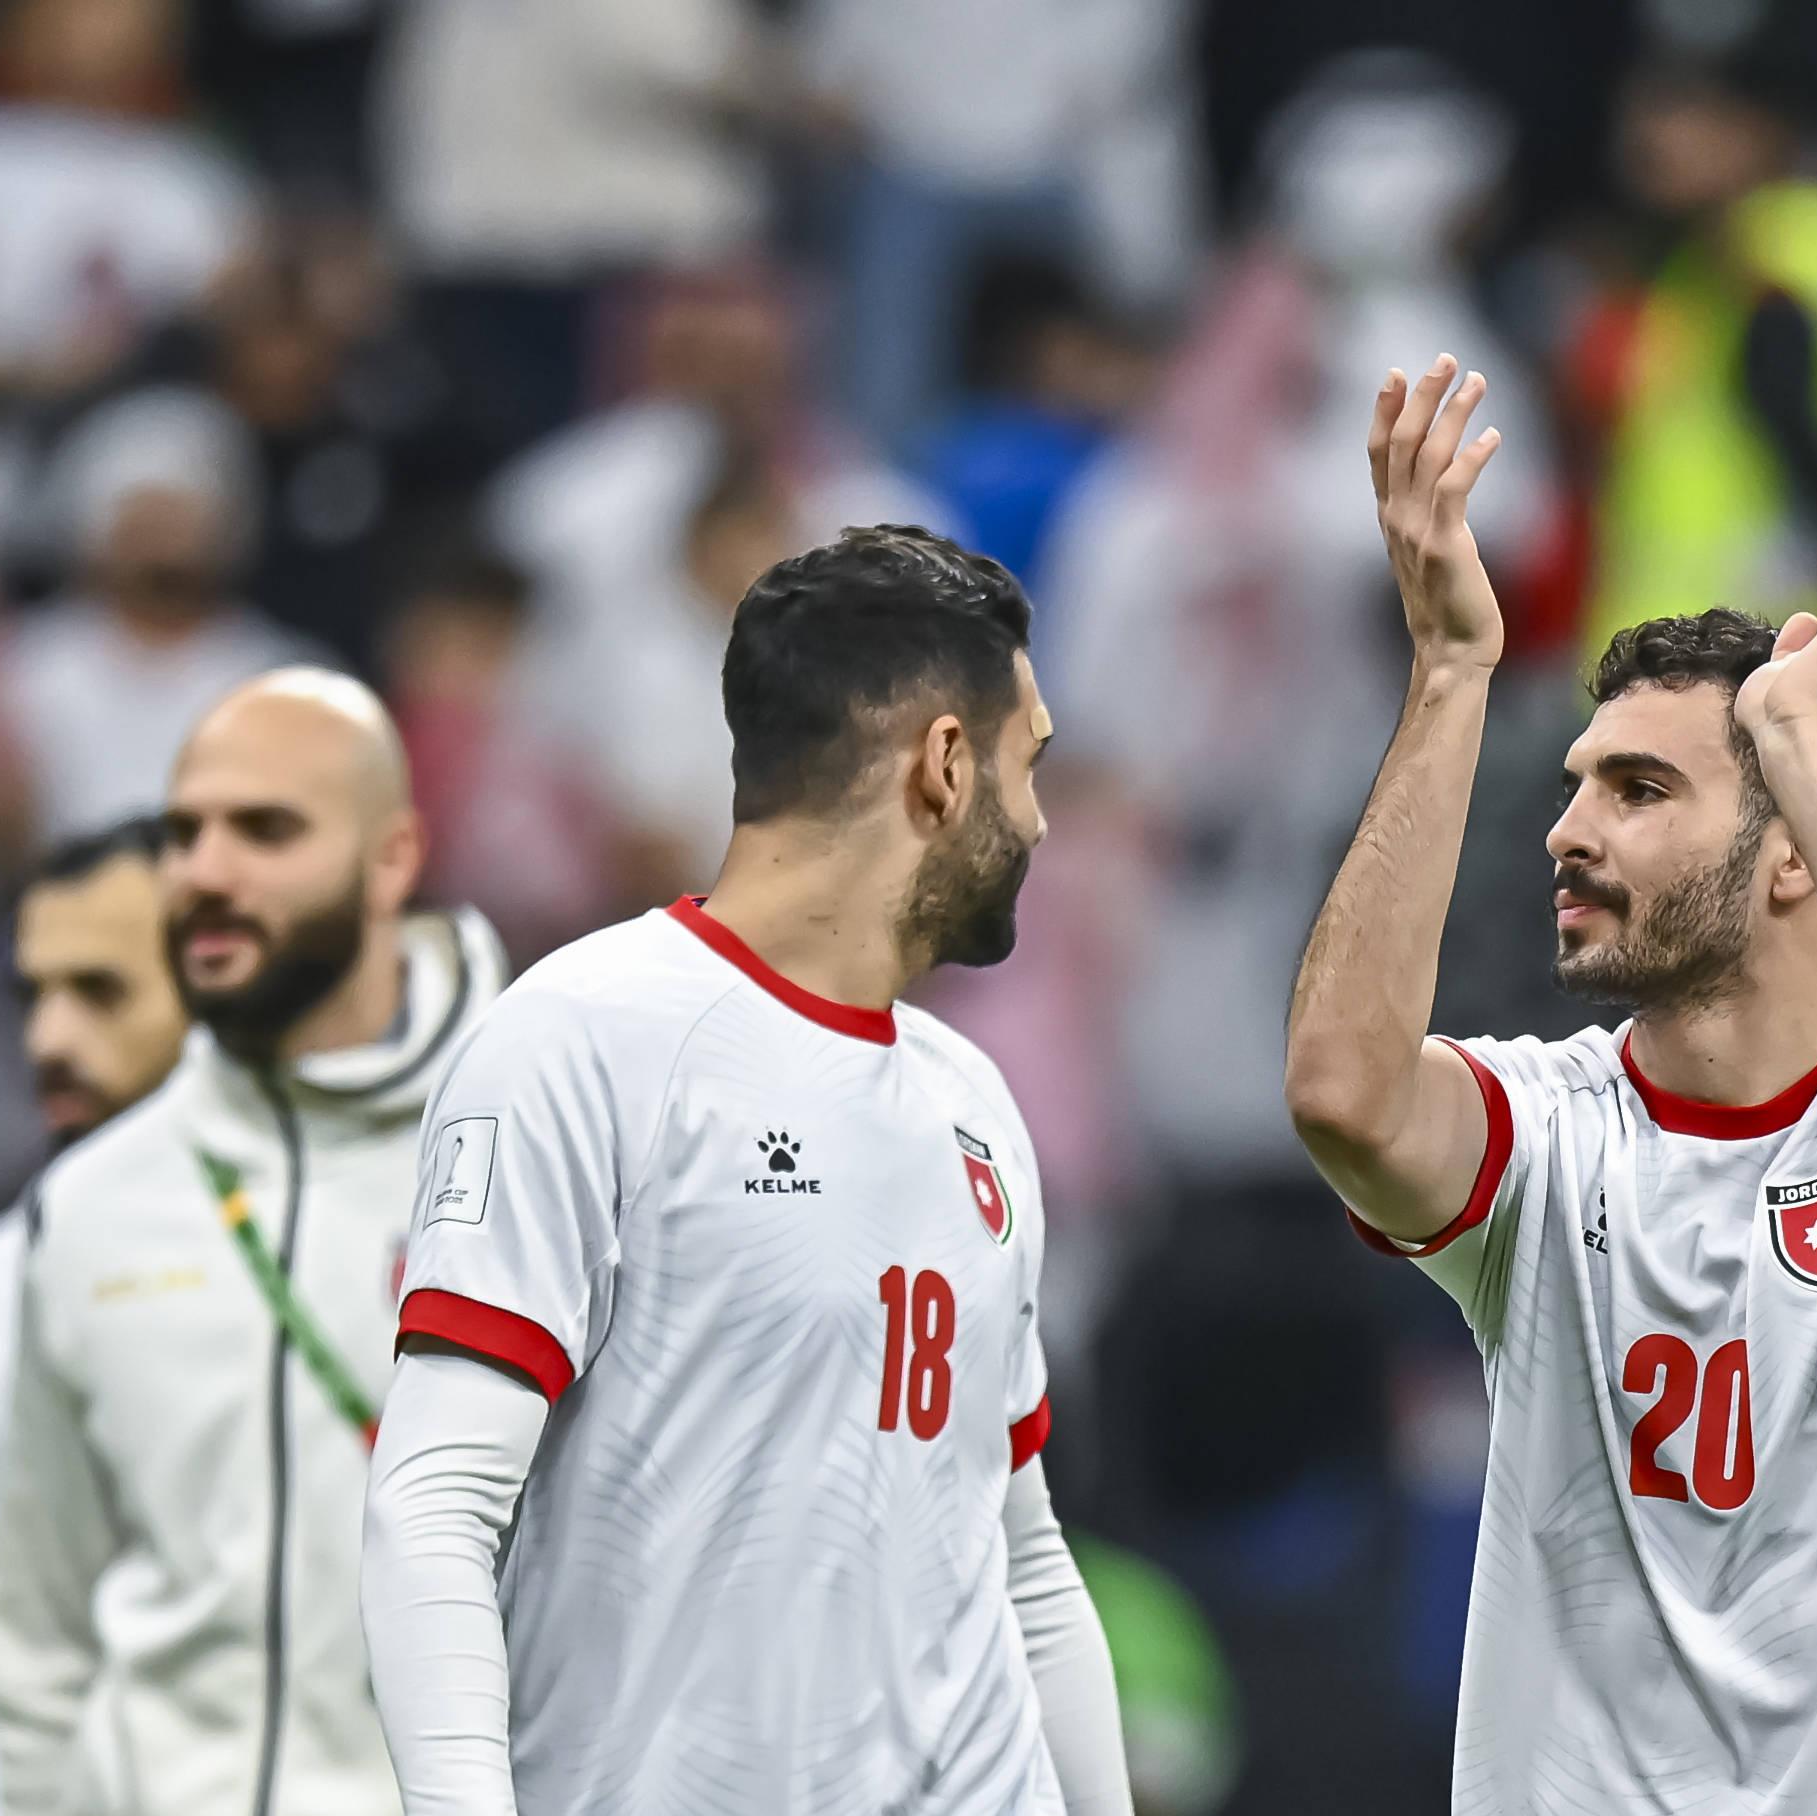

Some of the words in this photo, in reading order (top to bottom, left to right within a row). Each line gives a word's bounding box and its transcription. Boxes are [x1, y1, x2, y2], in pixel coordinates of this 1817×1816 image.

[743, 1178, 823, 1195] KELME
[878, 1264, 957, 1441] 18
[1622, 1332, 1756, 1512] 20
